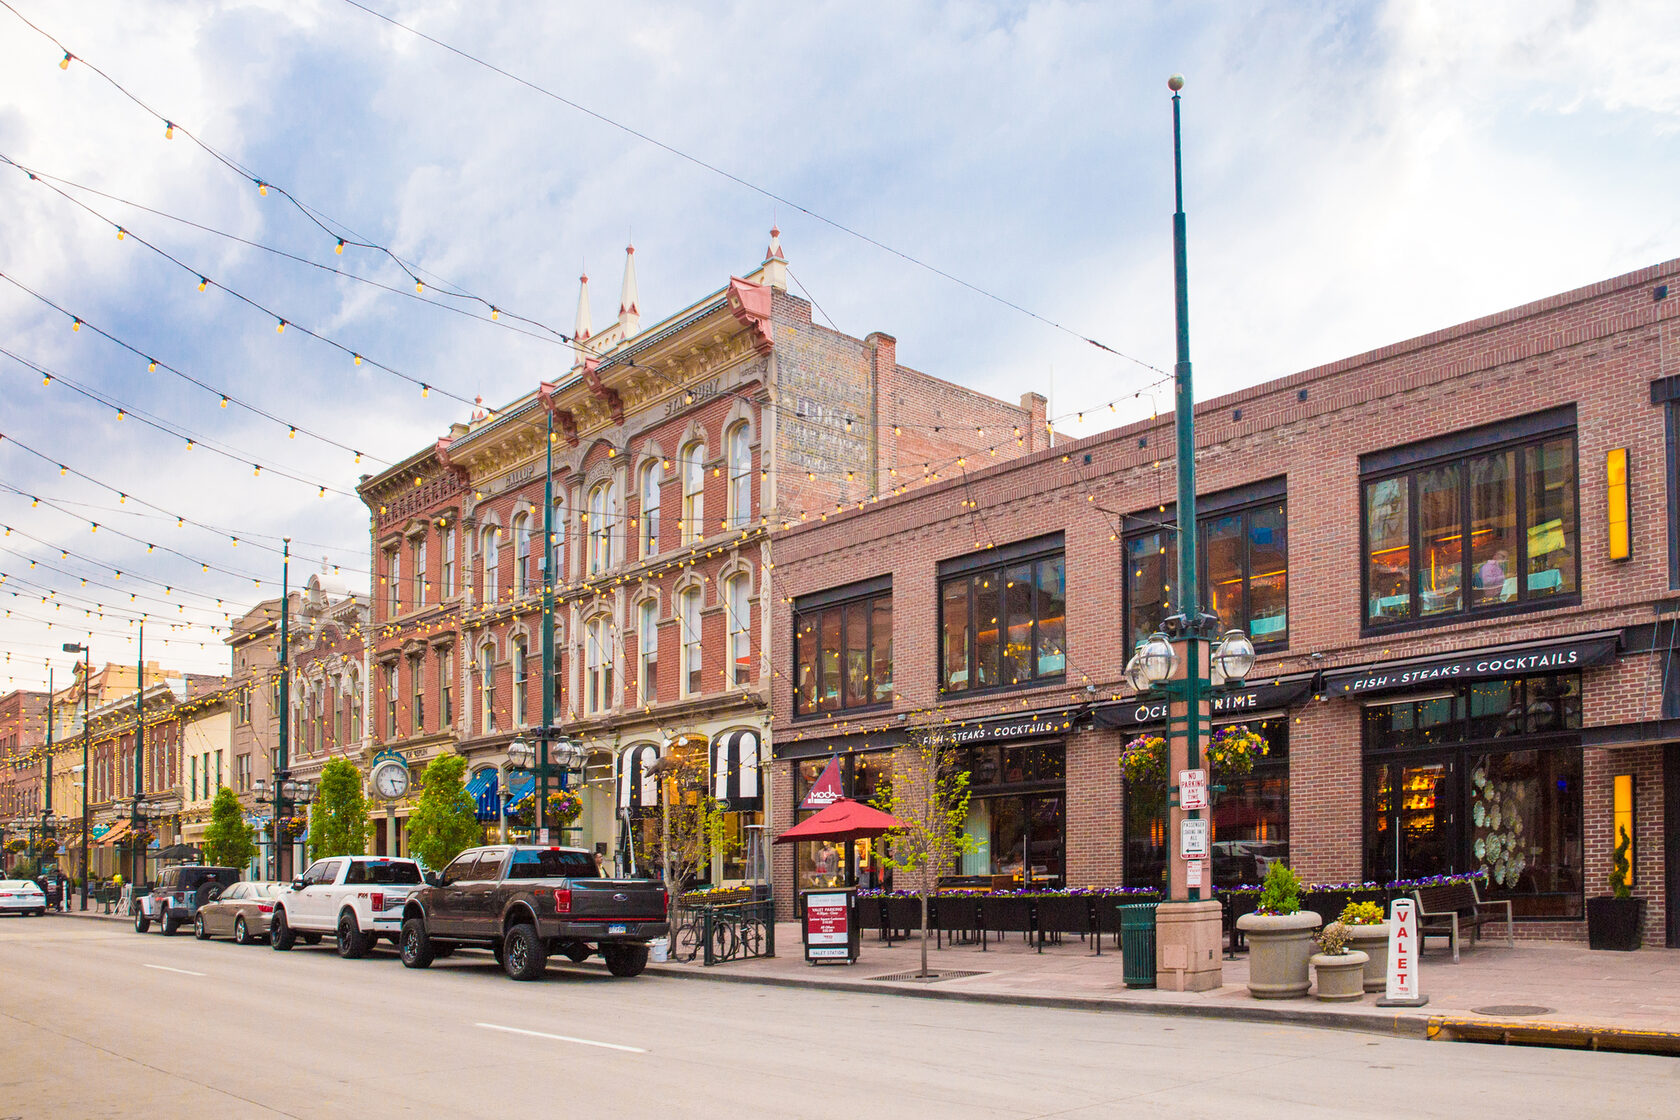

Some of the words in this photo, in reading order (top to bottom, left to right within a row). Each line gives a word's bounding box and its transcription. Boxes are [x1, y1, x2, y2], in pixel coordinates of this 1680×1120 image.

[1353, 677, 1387, 690] FISH
[1401, 665, 1460, 682] STEAKS
[1476, 651, 1578, 672] COCKTAILS
[1211, 694, 1257, 710] RIME
[922, 735, 943, 745] FISH
[951, 730, 986, 743] STEAKS
[994, 722, 1052, 737] COCKTAILS
[1181, 780, 1204, 788] PARKING
[1396, 911, 1409, 985] VALET
